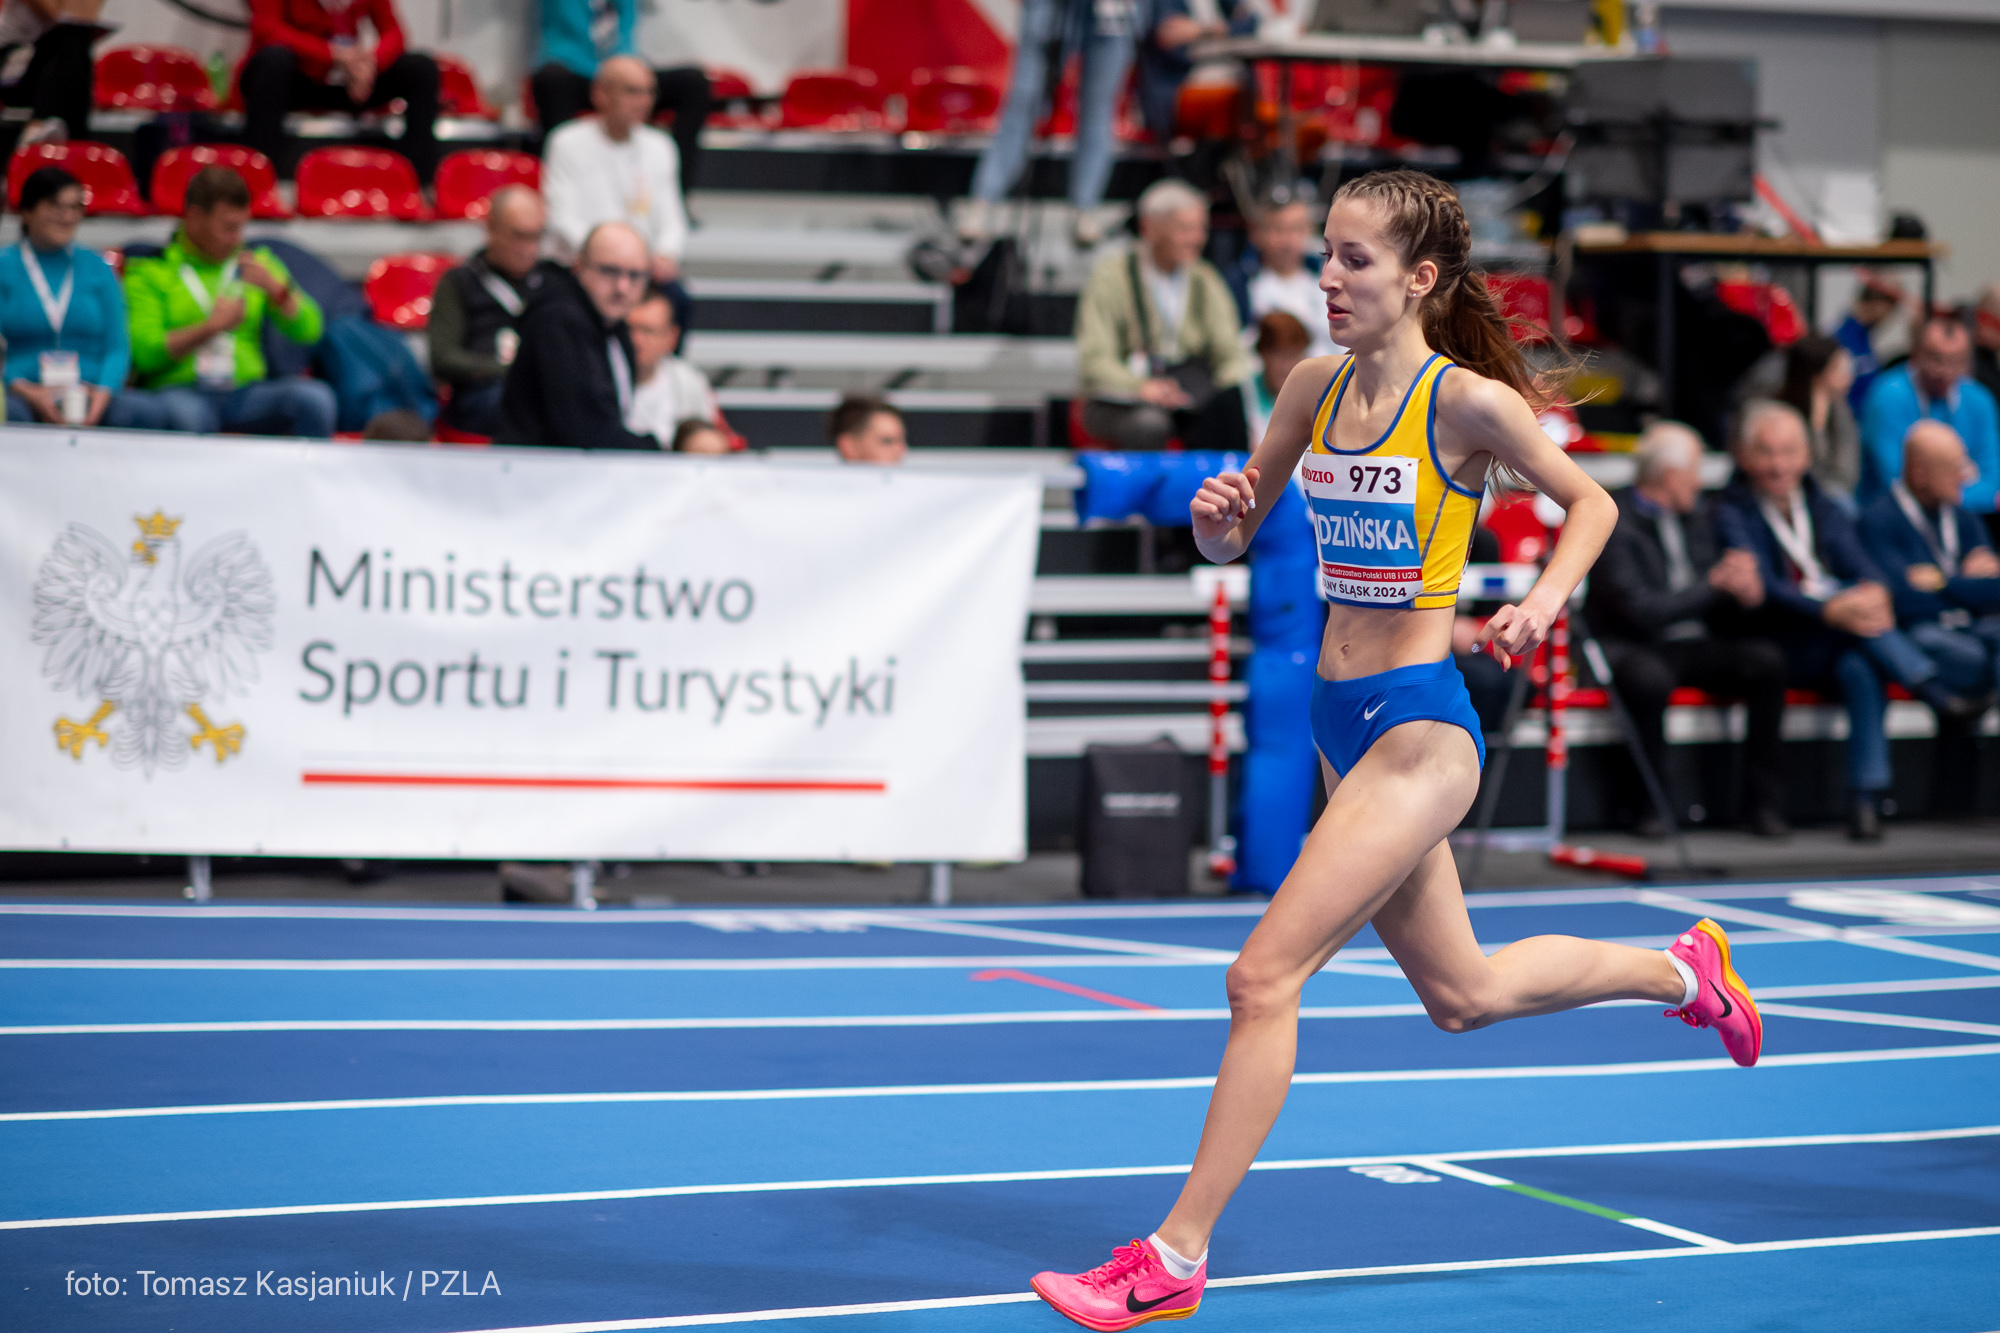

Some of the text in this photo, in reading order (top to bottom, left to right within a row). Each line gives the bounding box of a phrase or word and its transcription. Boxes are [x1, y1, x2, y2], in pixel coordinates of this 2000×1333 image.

[1349, 465, 1402, 494] 973
[1315, 510, 1415, 550] DZIŃSKA
[306, 546, 755, 623] Ministerstwo
[1329, 567, 1362, 578] Mistrzostwa
[1362, 571, 1383, 580] Polski
[1383, 572, 1397, 580] U18
[1401, 571, 1418, 579] U20
[1339, 581, 1371, 598] ŚLĄSK
[1373, 586, 1407, 597] 2024
[298, 640, 898, 727] Sportu i Turystyki
